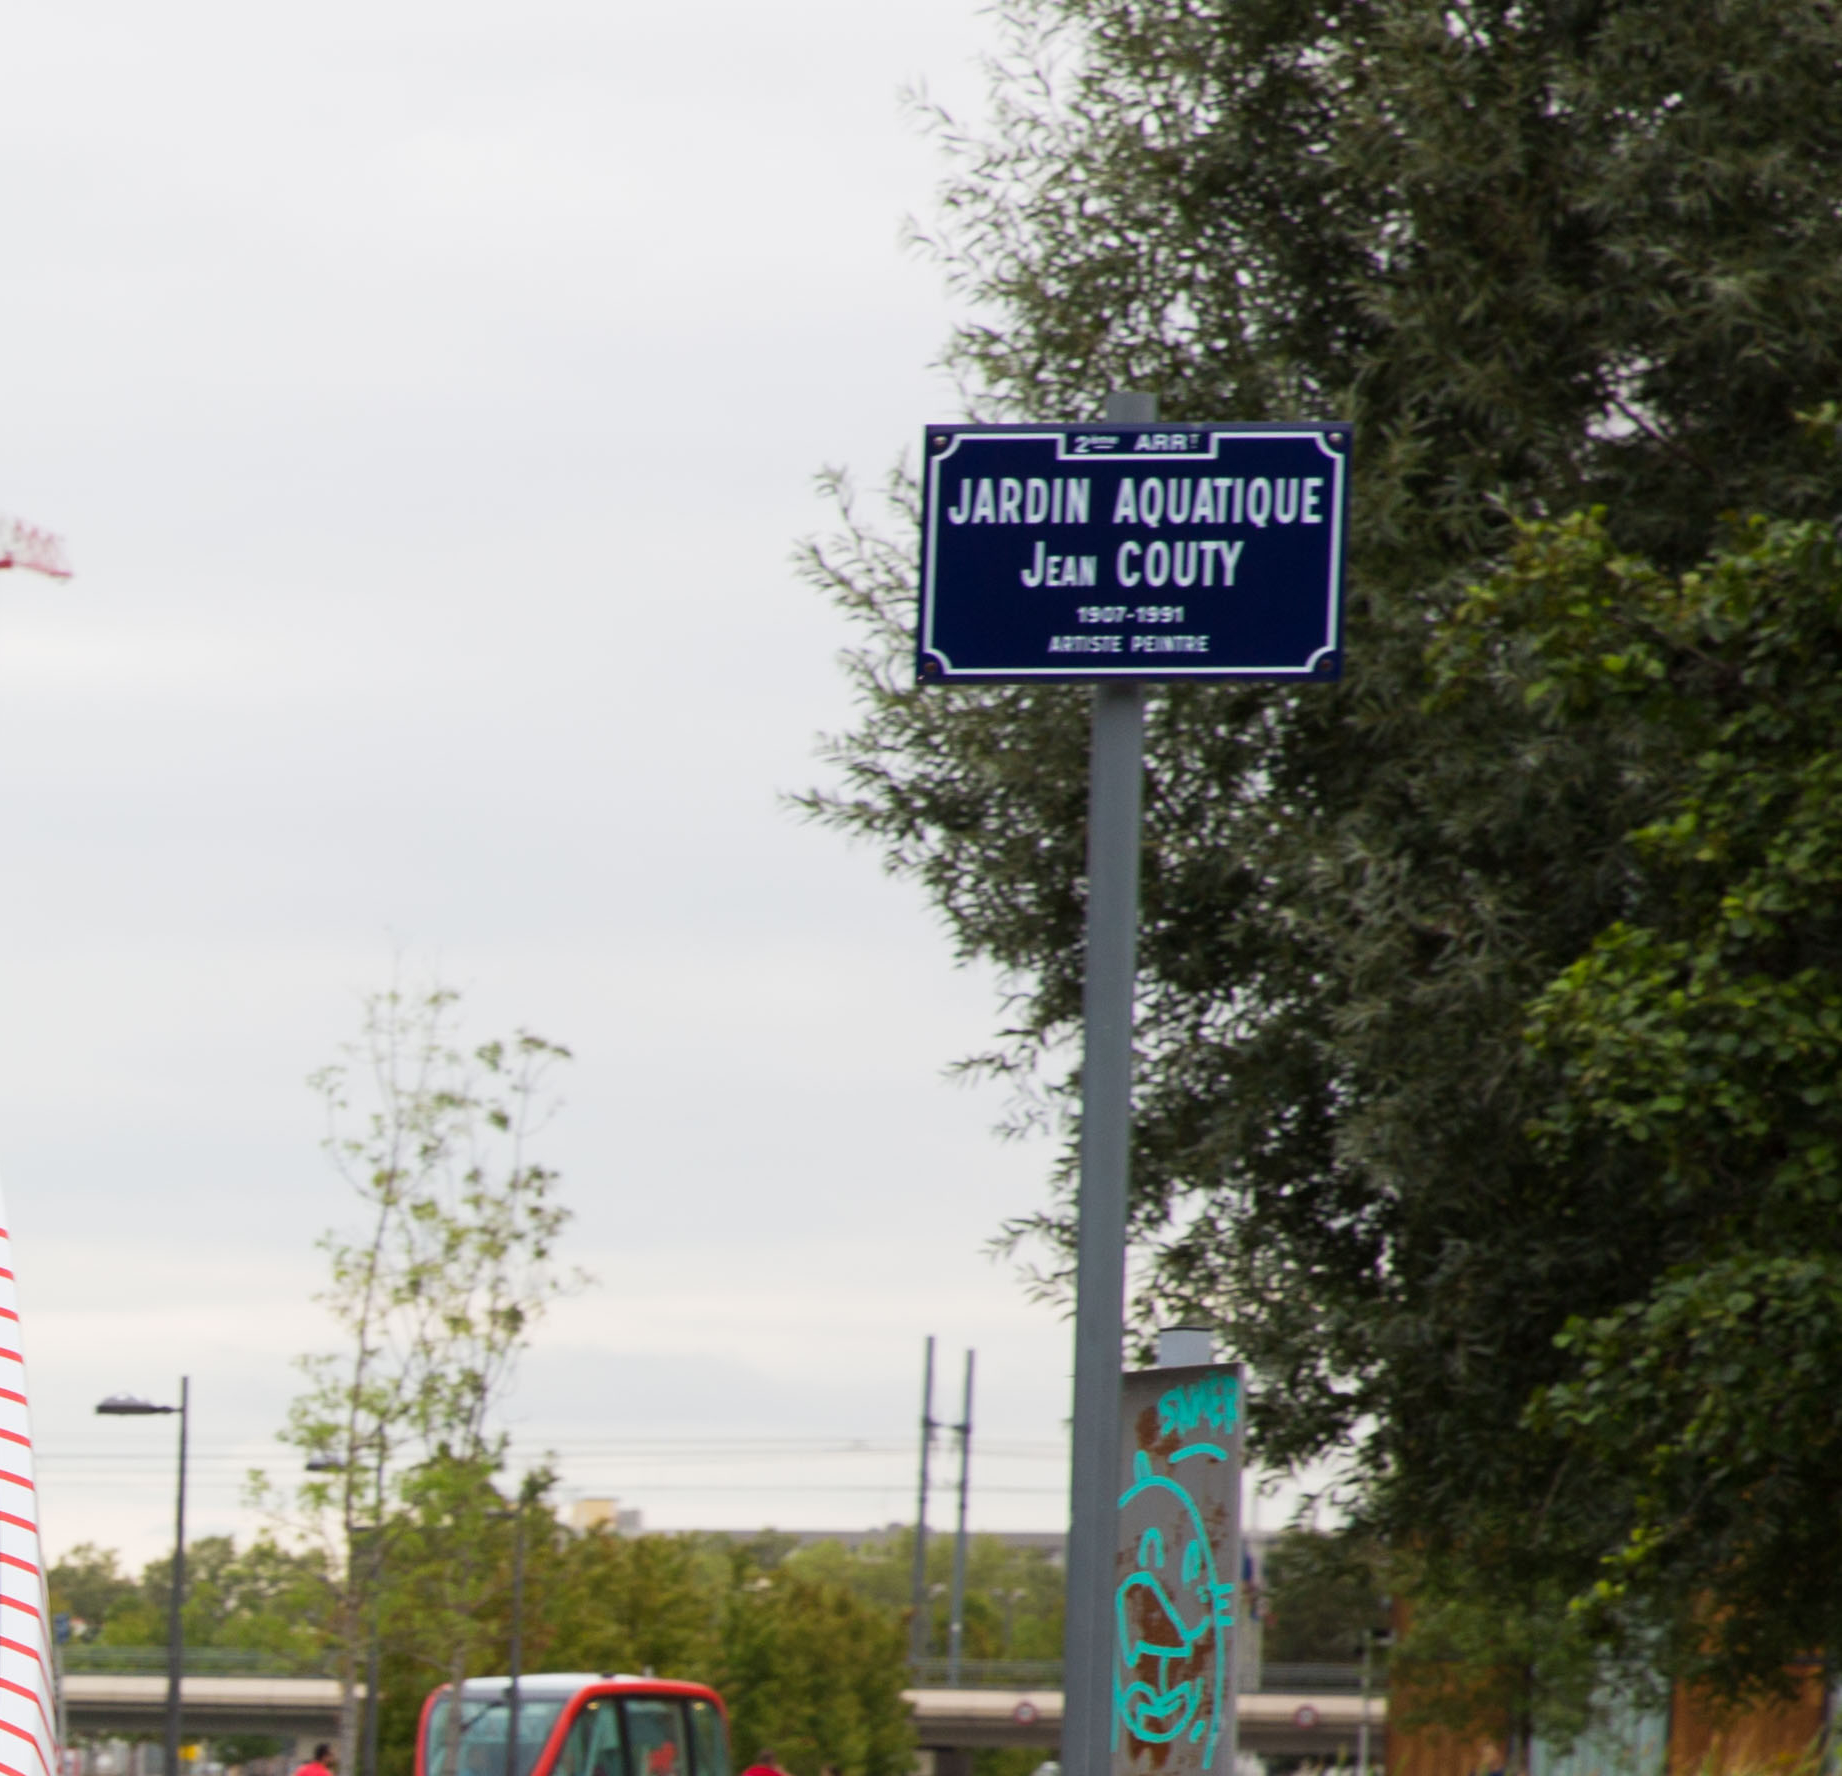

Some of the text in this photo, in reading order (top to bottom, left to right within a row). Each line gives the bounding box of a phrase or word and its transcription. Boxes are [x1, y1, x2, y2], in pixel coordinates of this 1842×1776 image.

[948, 477, 1324, 528] JARDIN AQUATIQUE
[1116, 540, 1245, 588] COUTY
[1076, 606, 1185, 624] 1907-1991
[1047, 635, 1211, 653] ARTISTE PEINTRE
